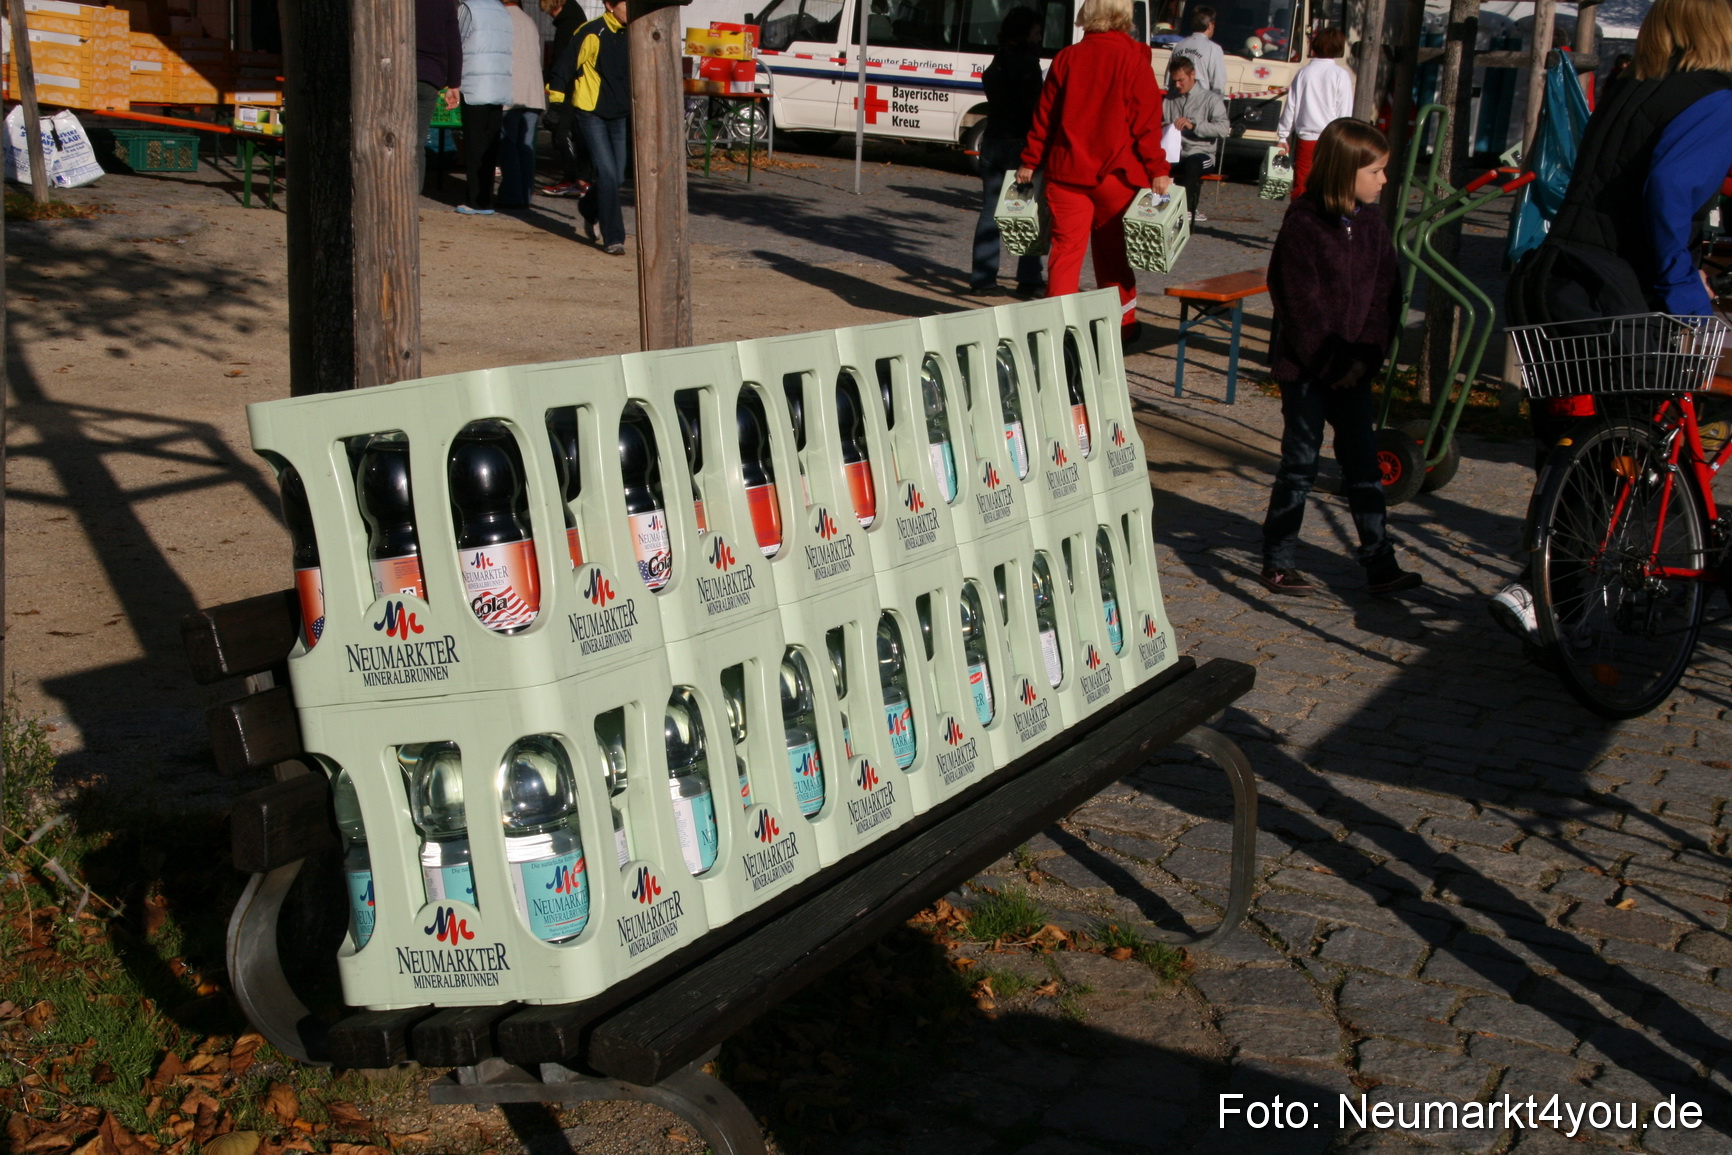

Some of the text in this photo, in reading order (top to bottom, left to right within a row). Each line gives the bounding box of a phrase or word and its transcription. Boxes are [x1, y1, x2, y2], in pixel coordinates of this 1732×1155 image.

[892, 87, 949, 102] Bayerisches
[892, 101, 919, 114] Rotes
[892, 116, 920, 129] Kreuz
[1106, 442, 1136, 469] NEUMARKTER
[1046, 462, 1080, 490] NEUMARKTER
[975, 484, 1014, 514] NEUMARKTER
[896, 508, 940, 540] NEUMARKTER
[804, 533, 855, 570] NEUMARKTER
[903, 531, 937, 550] MINERALBRUNNEN
[696, 564, 756, 604] NEUMARKTER
[814, 558, 852, 581] MINERALBRUNNEN
[471, 596, 508, 619] Cola
[706, 591, 752, 616] MINERALBRUNNEN
[568, 598, 639, 643] NEUMARKTER
[345, 634, 461, 673] NEUMARKTER
[579, 628, 633, 656] MINERALBRUNNEN
[1138, 631, 1168, 662] NEUMARKTER
[362, 665, 449, 687] MINERALBRUNNEN
[1080, 662, 1113, 697] NEUMARKTER
[1012, 698, 1050, 734] NEUMARKTER
[936, 737, 979, 776] NEUMARKTER
[943, 765, 976, 786] MINERALBRUNNEN
[846, 781, 896, 825] NEUMARKTER
[855, 806, 892, 835] MINERALBRUNNEN
[742, 831, 799, 881] NEUMARKTER
[751, 859, 795, 892] MINERALBRUNNEN
[616, 890, 684, 947] NEUMARKTER
[627, 920, 679, 958] MINERALBRUNNEN
[395, 942, 511, 974] NEUMARKTER
[413, 972, 500, 989] MINERALBRUNNEN
